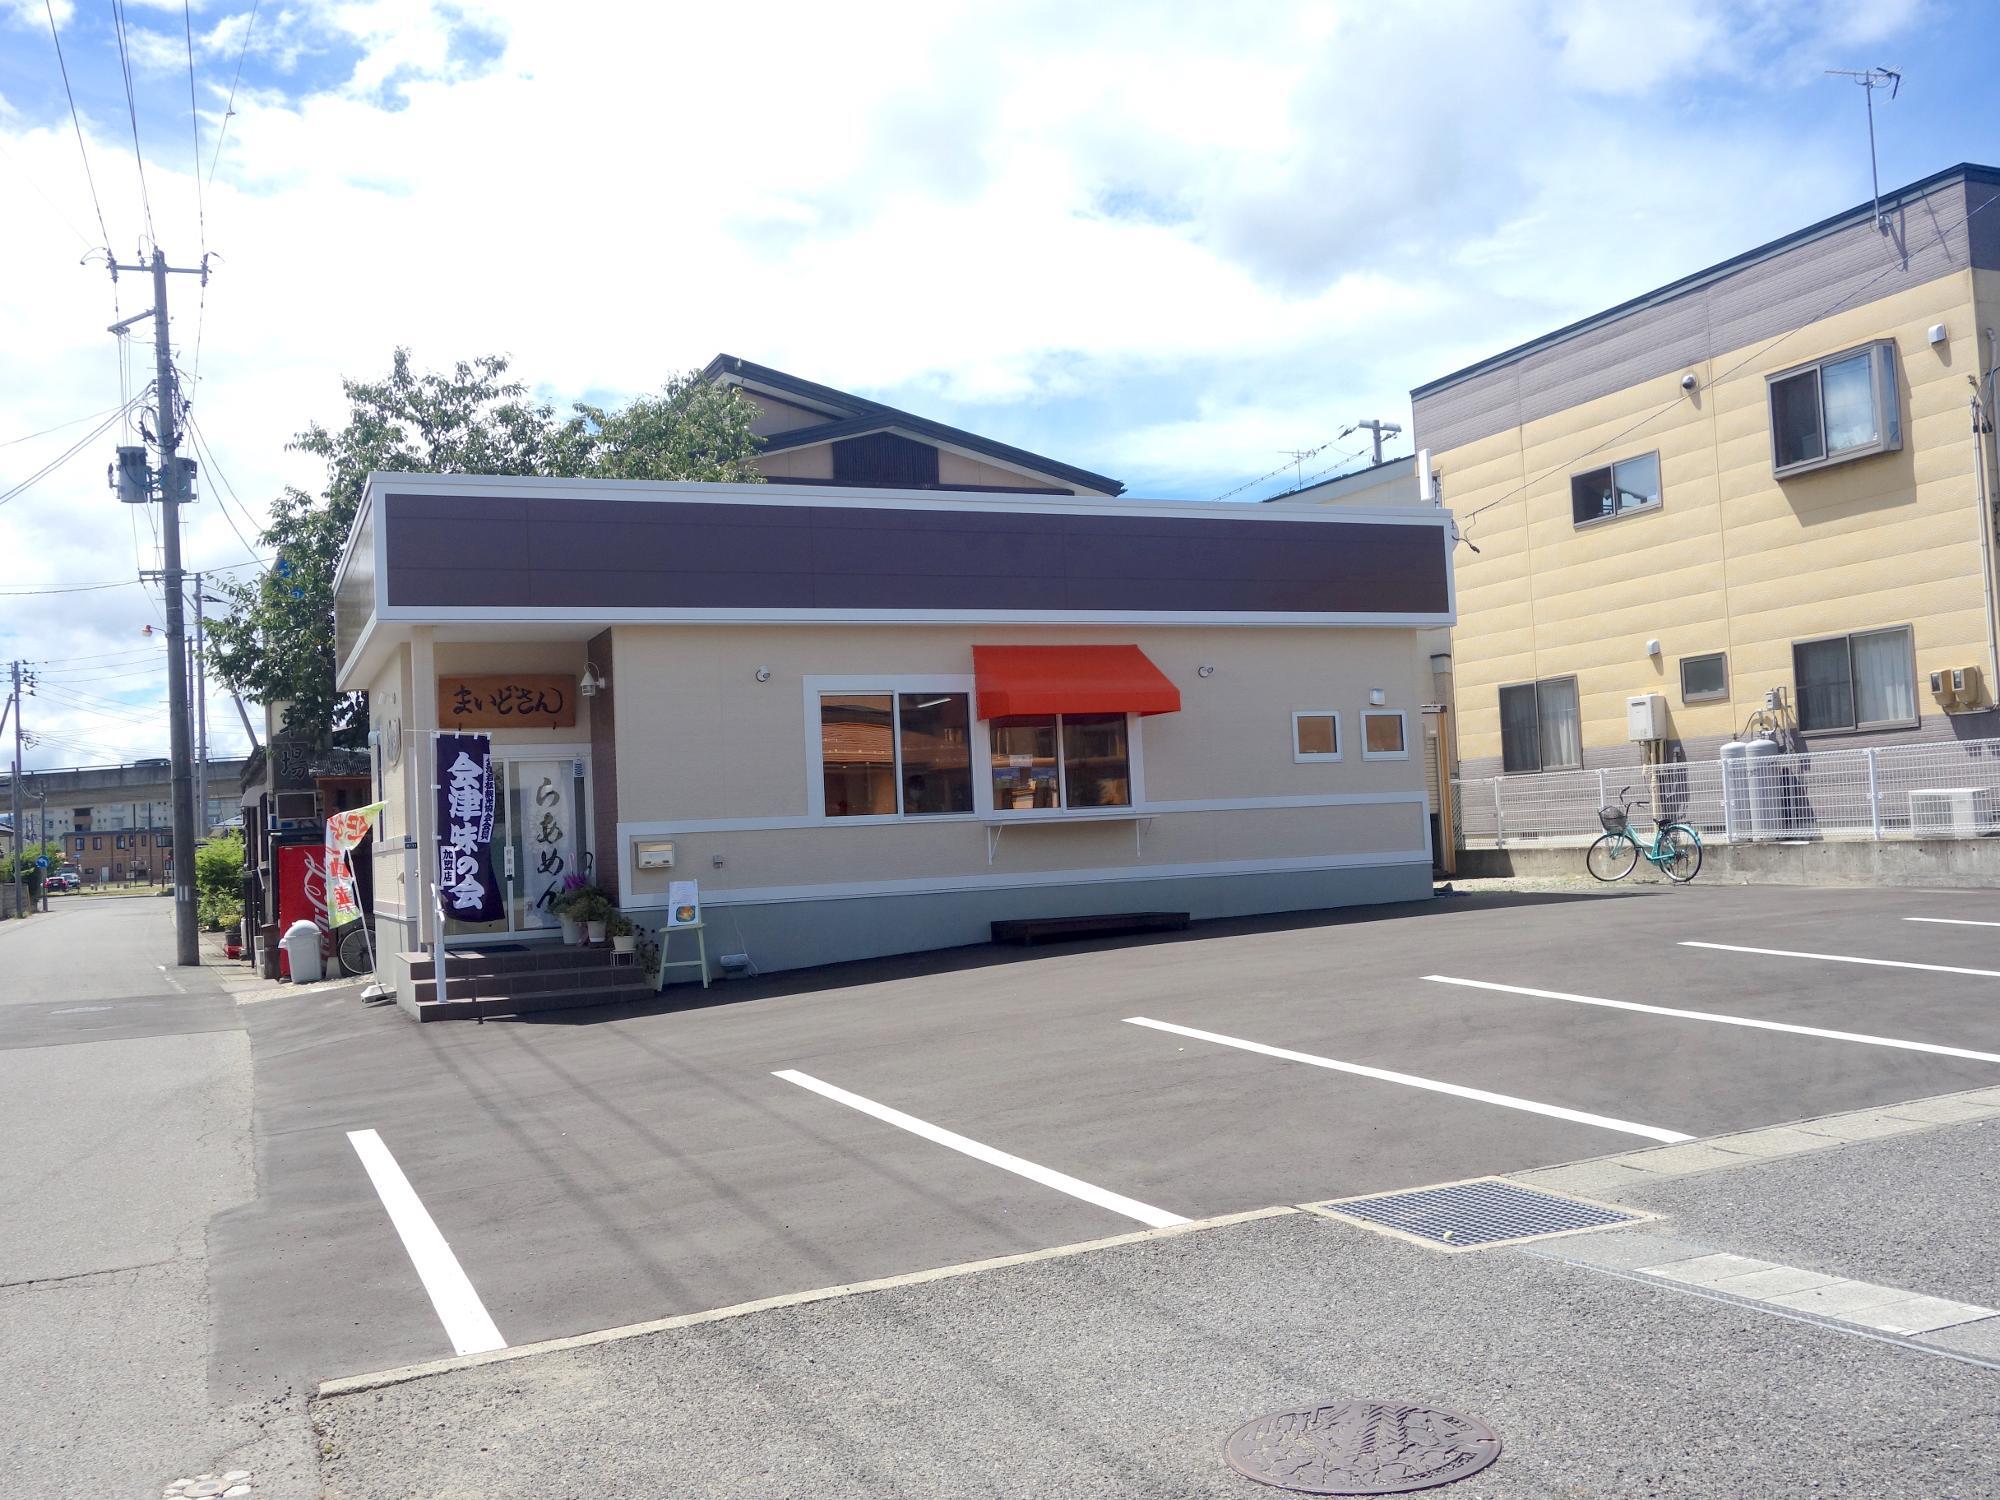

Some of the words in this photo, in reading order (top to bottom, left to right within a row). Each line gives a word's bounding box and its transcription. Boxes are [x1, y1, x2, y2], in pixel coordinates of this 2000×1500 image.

[453, 685, 563, 714] まいどさん
[447, 752, 484, 909] 会津味の会
[443, 849, 453, 882] 加盟店
